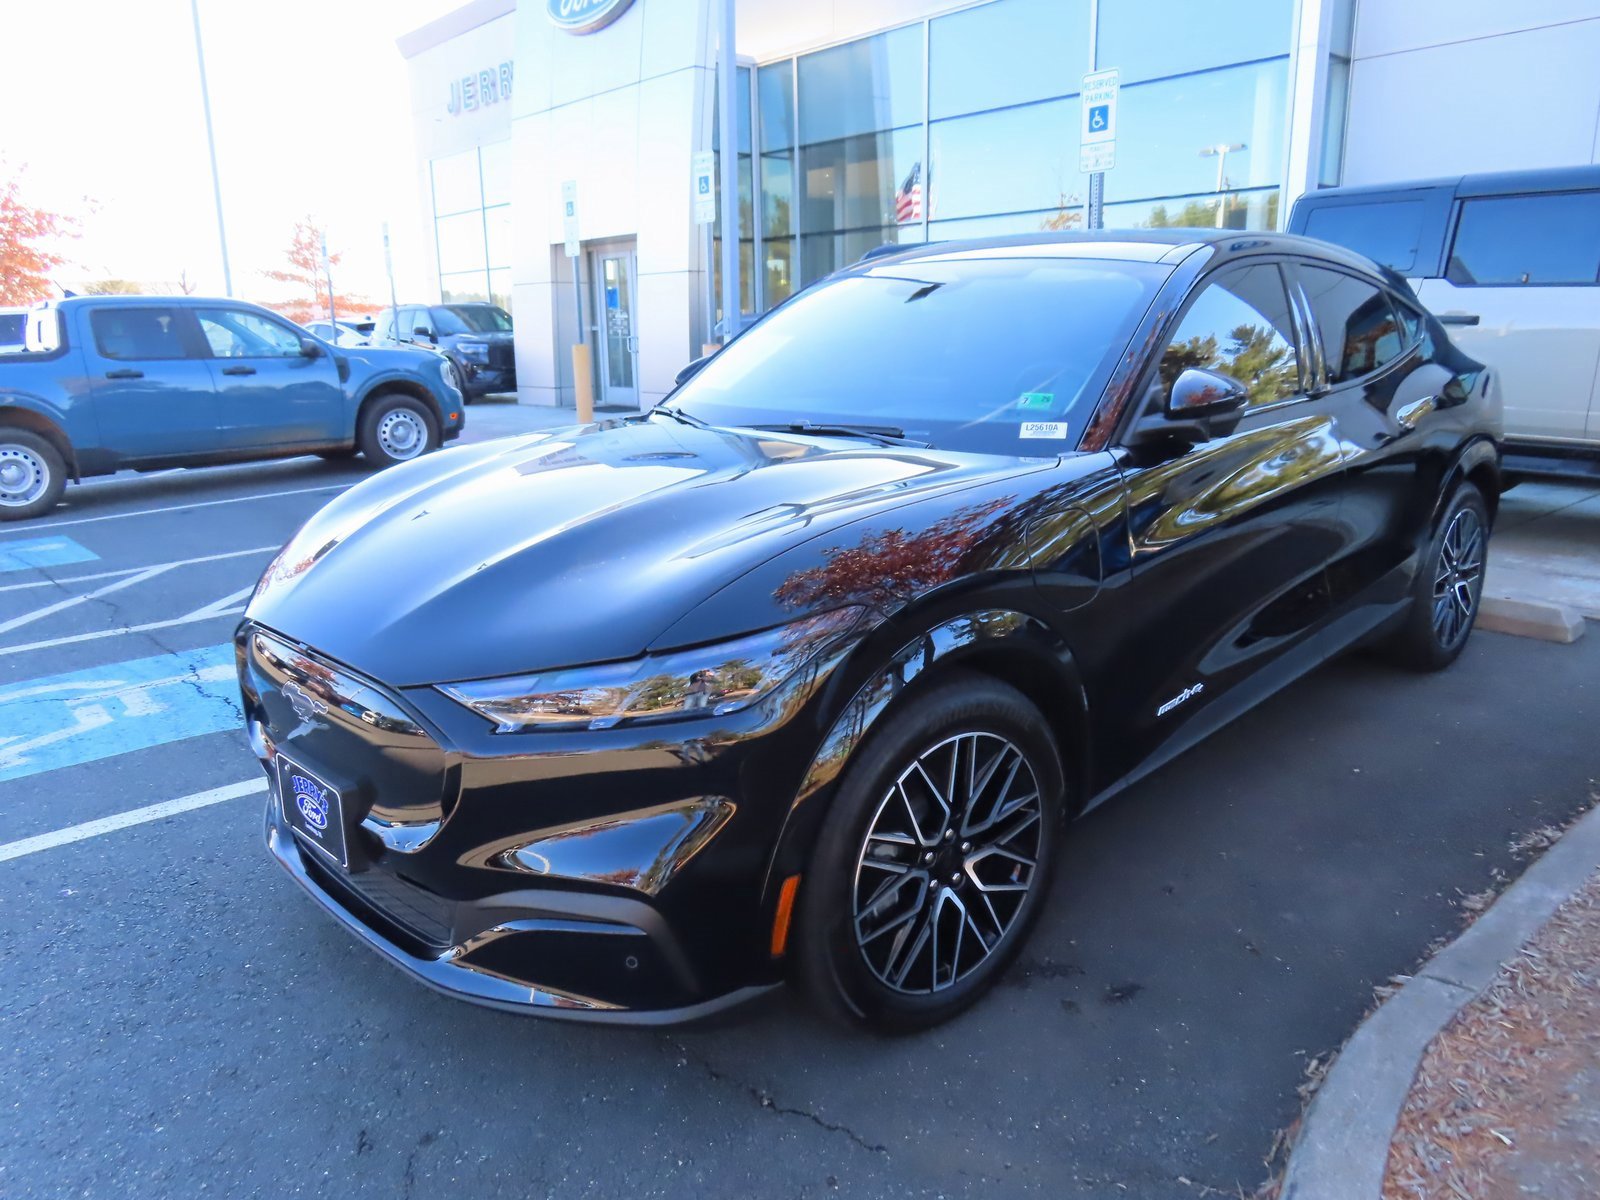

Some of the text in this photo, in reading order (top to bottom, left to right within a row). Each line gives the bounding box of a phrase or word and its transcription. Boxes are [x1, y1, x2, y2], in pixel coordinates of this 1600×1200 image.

[1084, 76, 1118, 91] RESERVED
[1085, 90, 1115, 104] PARKING
[1025, 423, 1059, 431] L25610A
